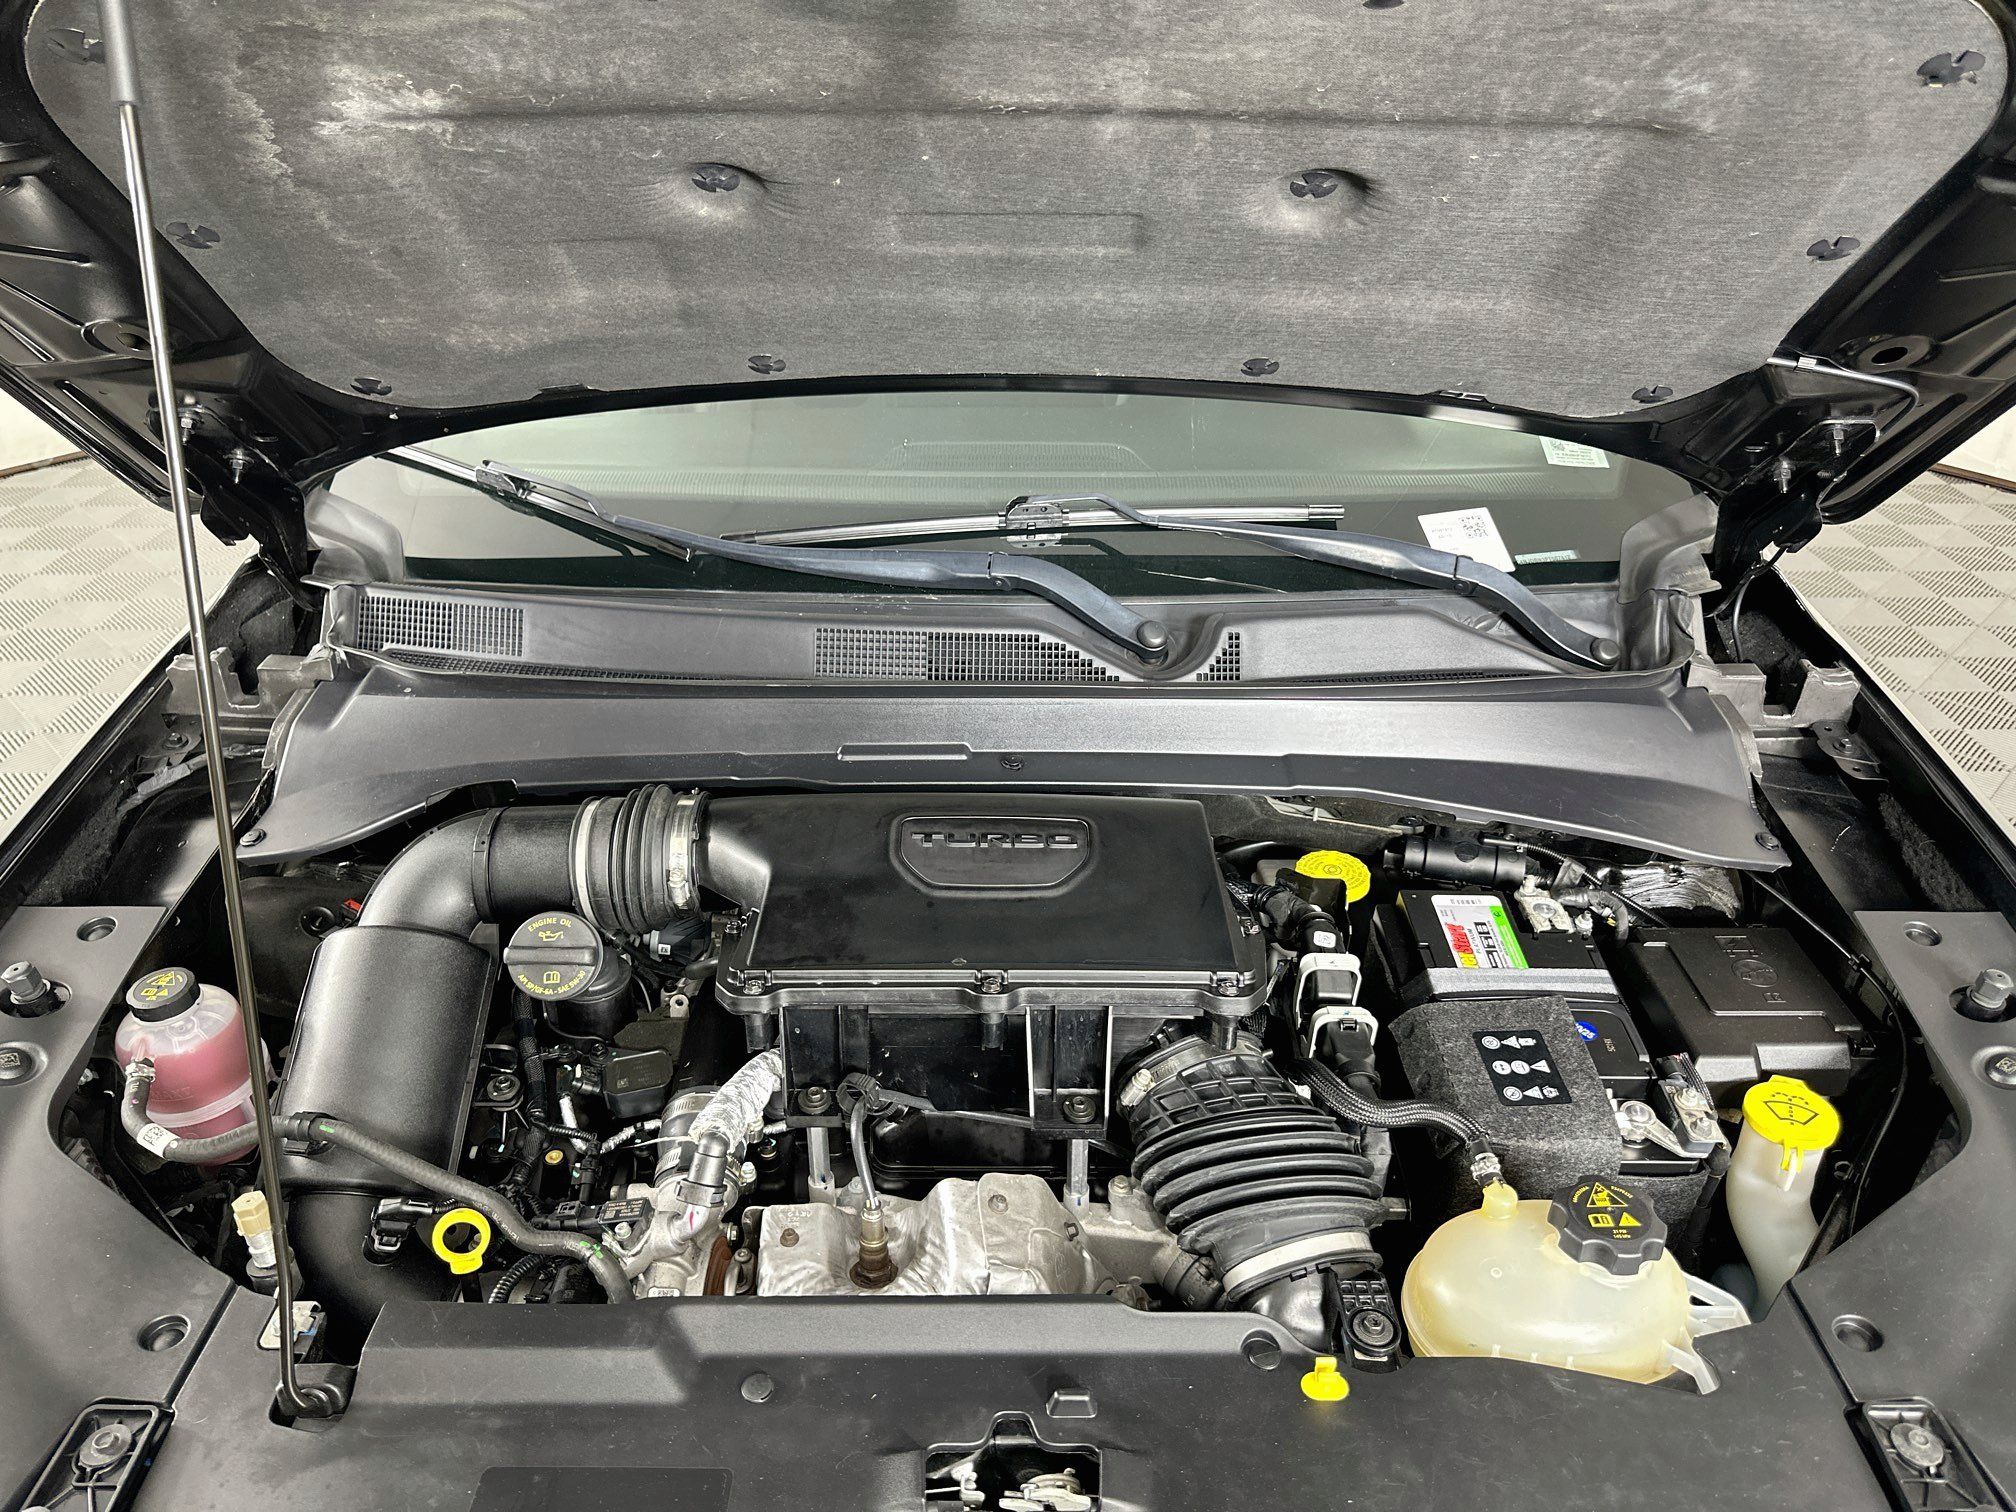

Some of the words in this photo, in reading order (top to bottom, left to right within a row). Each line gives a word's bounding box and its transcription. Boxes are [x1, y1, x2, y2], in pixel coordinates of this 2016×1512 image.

[911, 832, 1079, 849] TURBO
[527, 917, 557, 932] ENGINE
[559, 918, 572, 928] OIL
[518, 974, 527, 985] API
[557, 984, 570, 994] SAE
[568, 970, 586, 989] 5W-30
